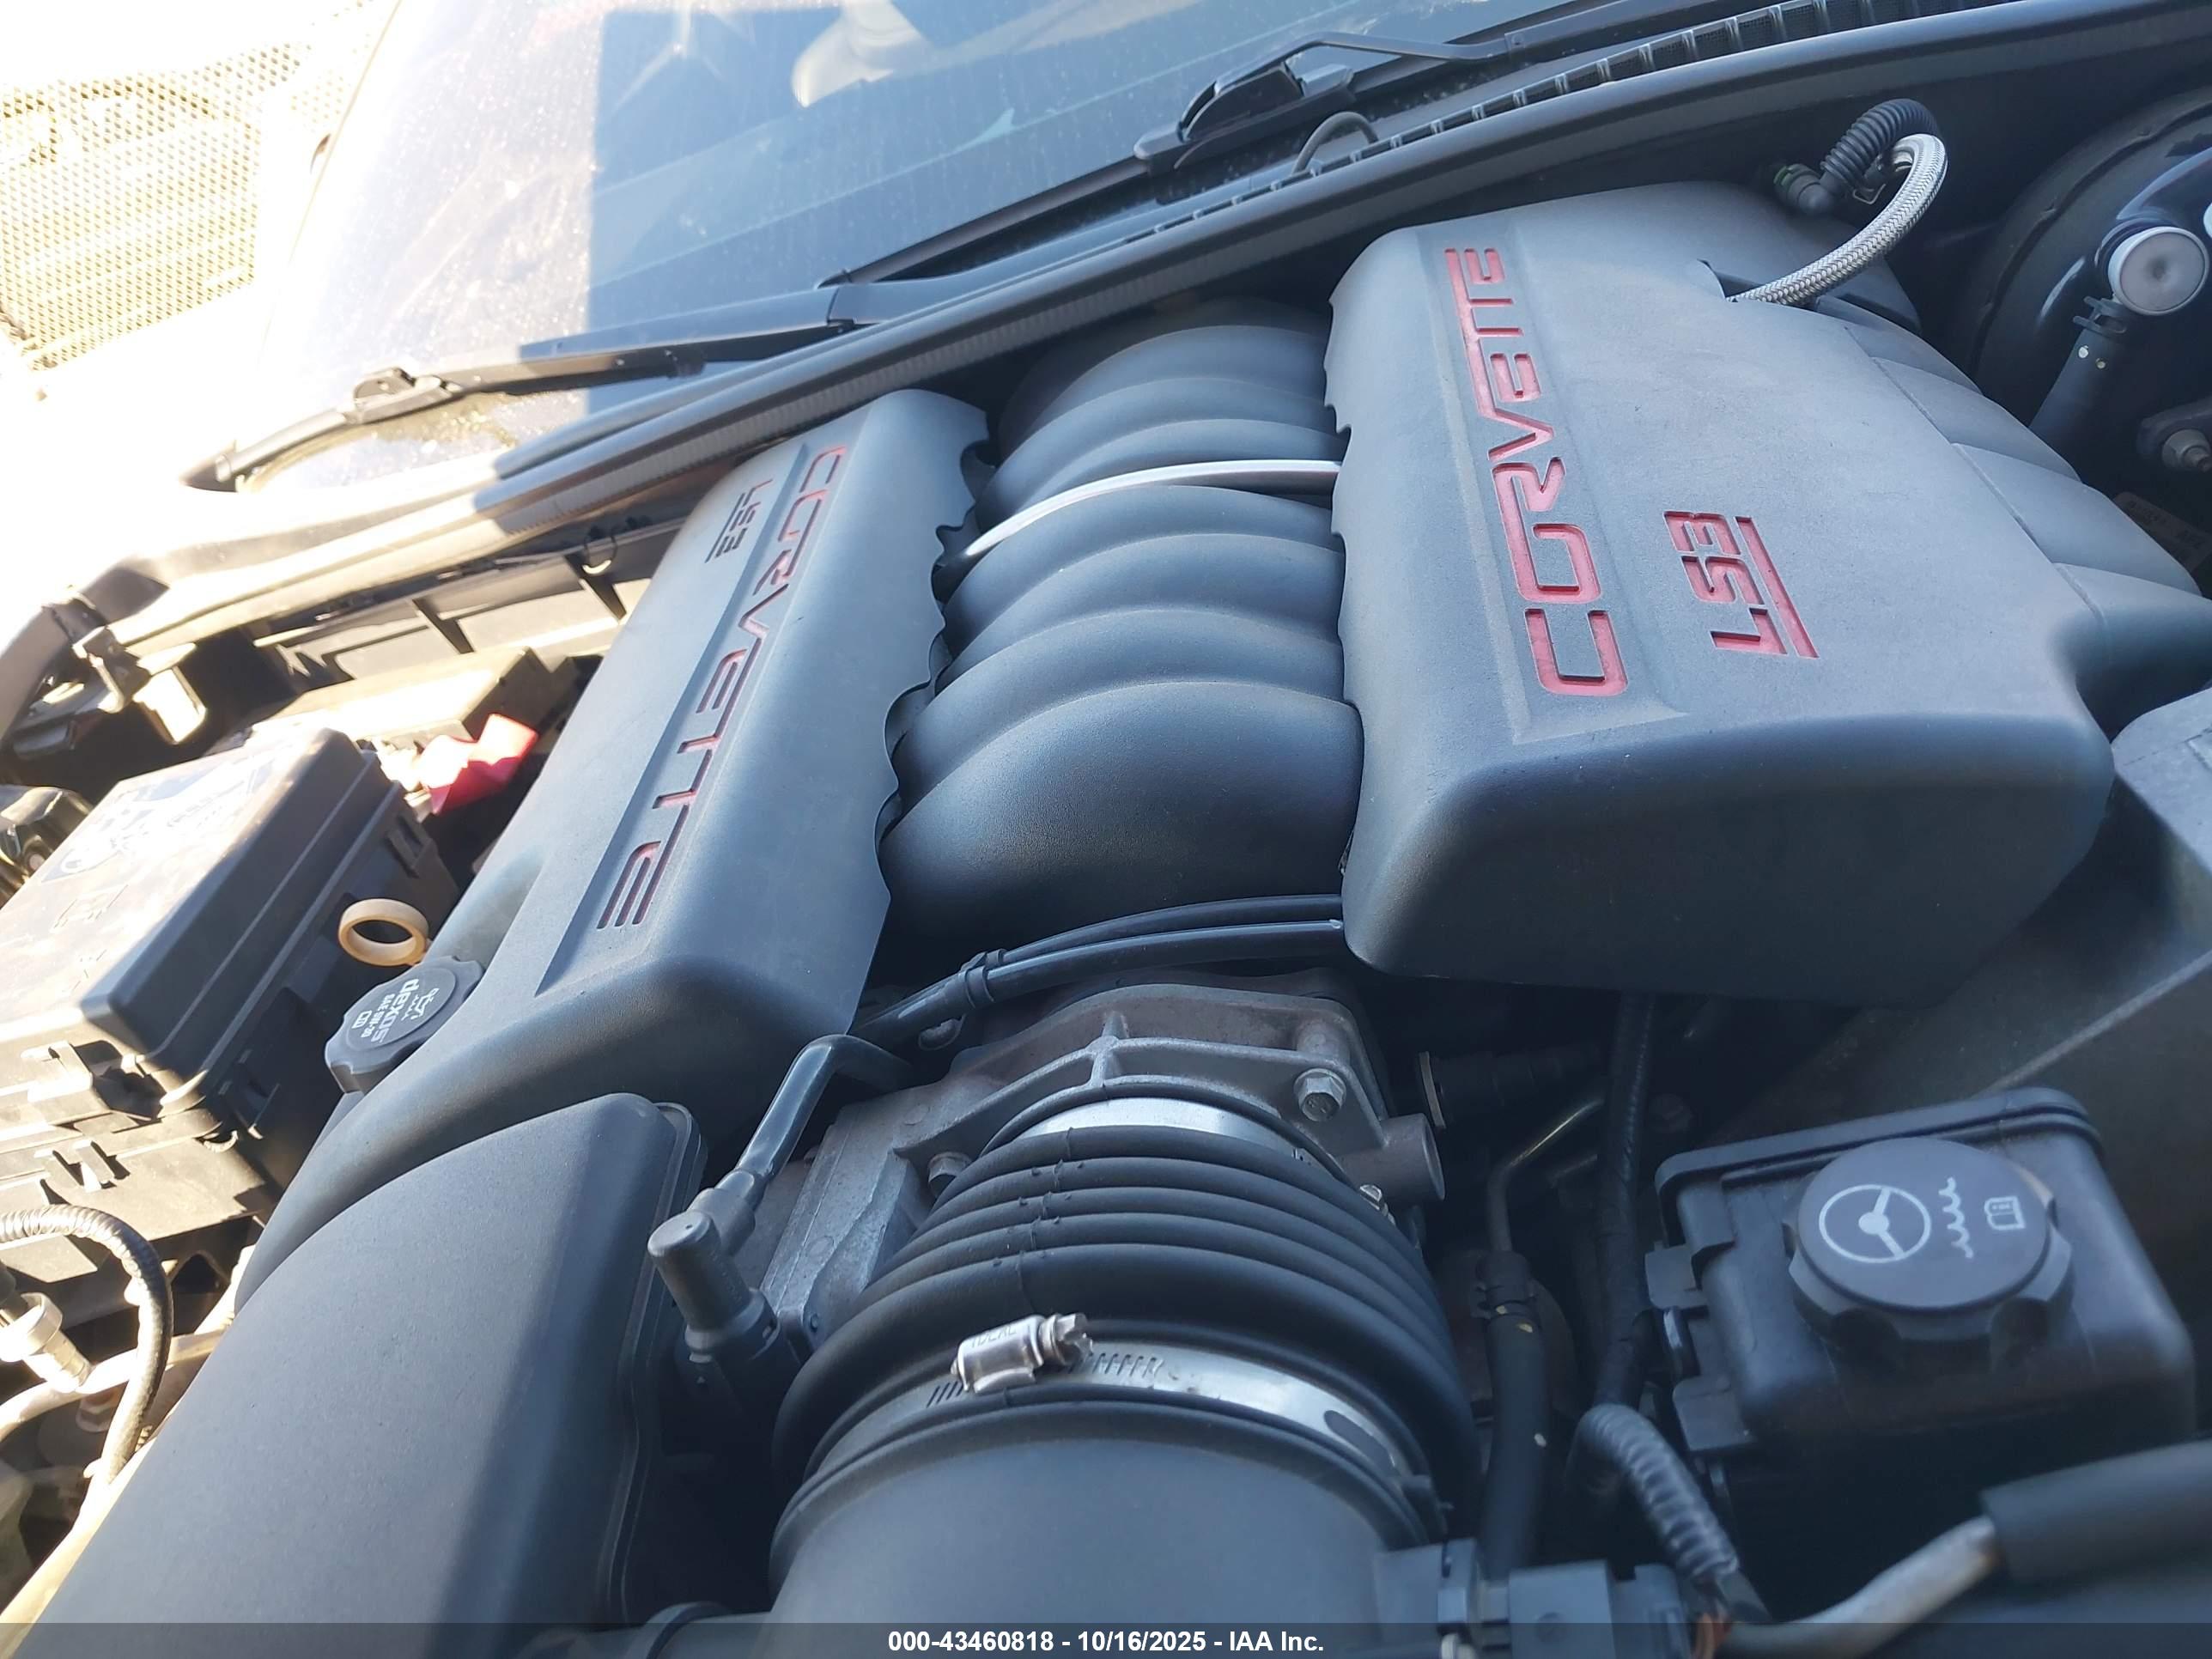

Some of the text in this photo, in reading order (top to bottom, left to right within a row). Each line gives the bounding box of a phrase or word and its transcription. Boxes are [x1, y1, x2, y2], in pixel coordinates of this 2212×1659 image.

[714, 477, 774, 560] LS3
[1445, 247, 1628, 696] CORVETTE
[1663, 510, 1787, 655] LS3
[596, 446, 848, 929] CORVETTE
[371, 979, 419, 1042] dexos
